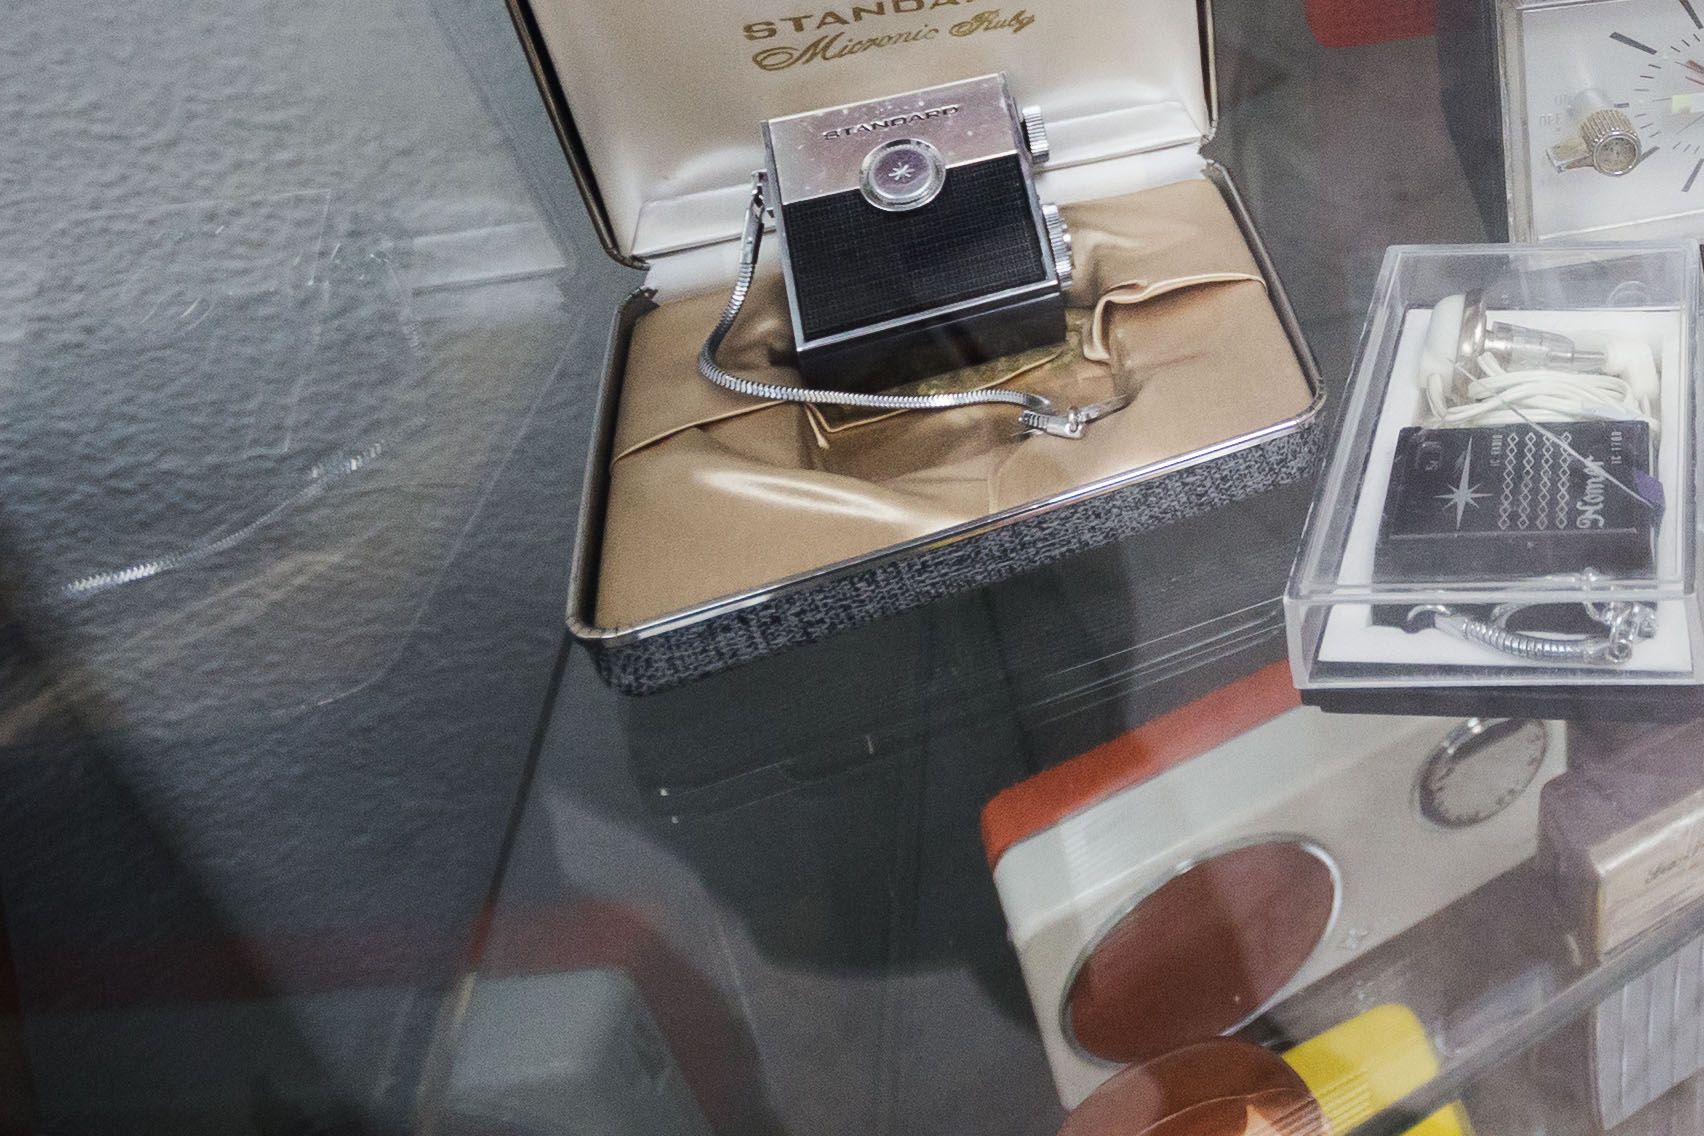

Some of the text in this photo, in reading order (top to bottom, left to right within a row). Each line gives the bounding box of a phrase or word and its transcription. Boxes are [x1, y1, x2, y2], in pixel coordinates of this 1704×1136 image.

[751, 9, 1036, 72] Micronic Ruby
[822, 104, 961, 141] STANDARD
